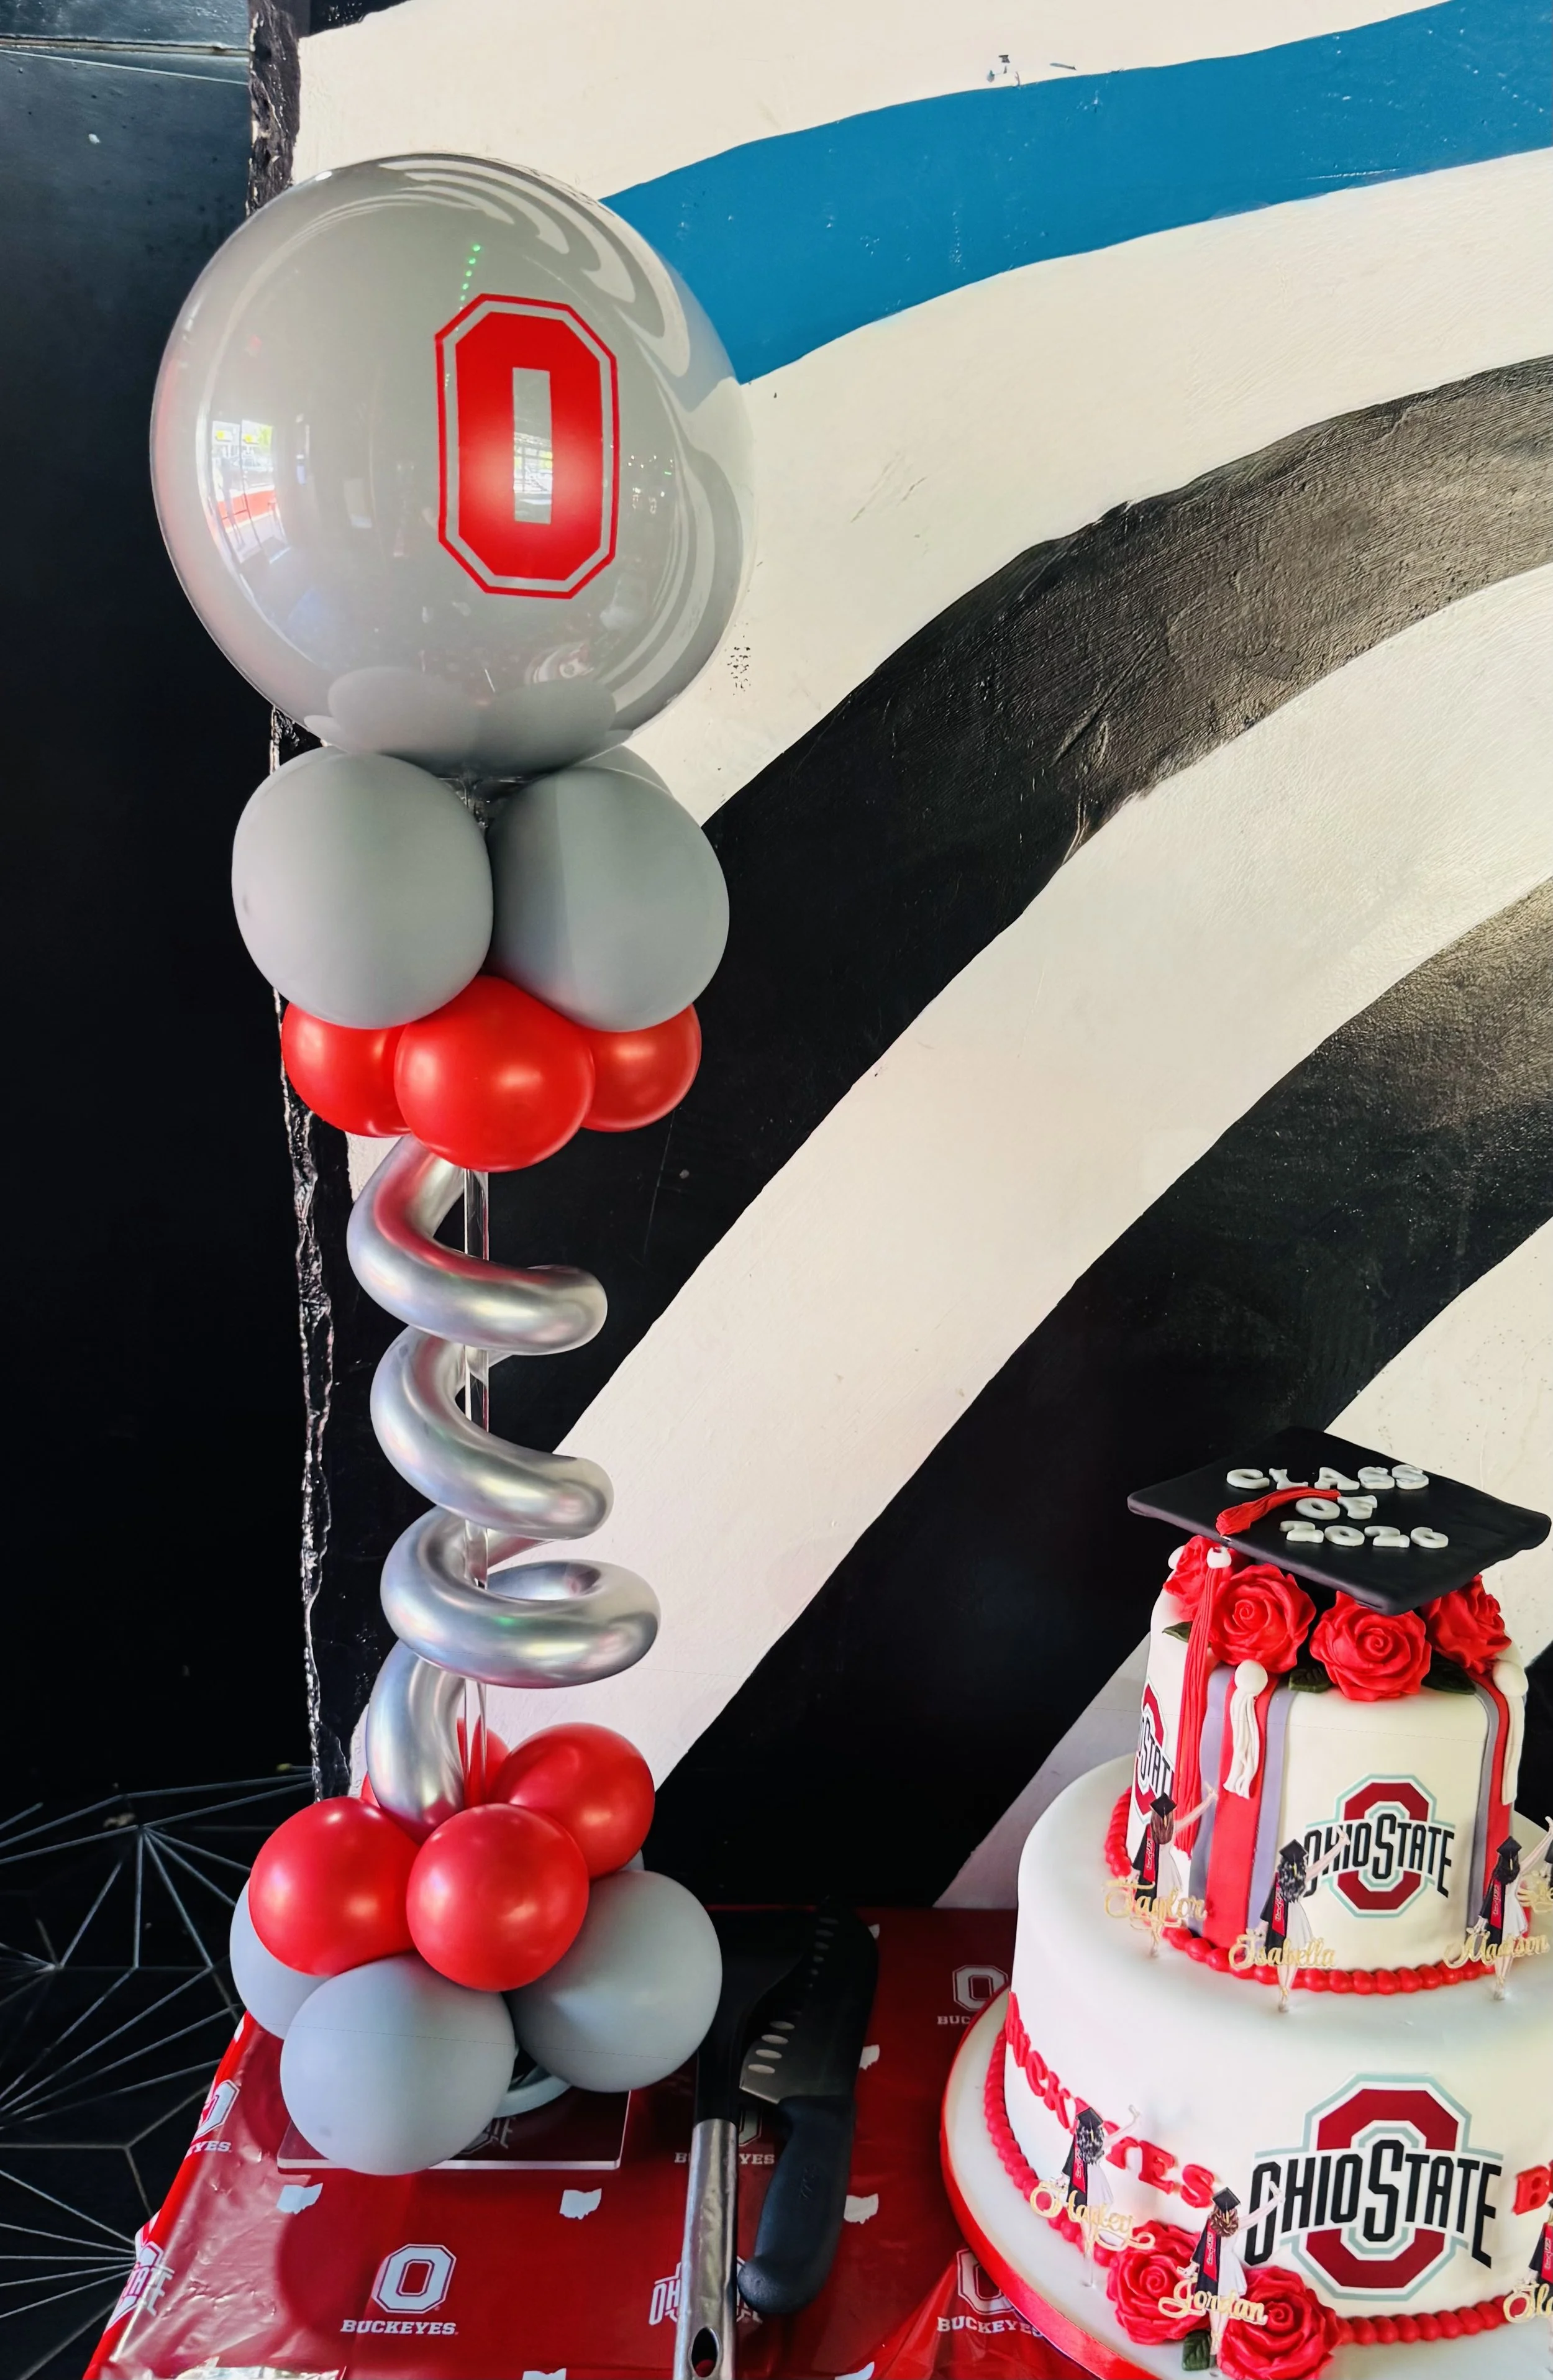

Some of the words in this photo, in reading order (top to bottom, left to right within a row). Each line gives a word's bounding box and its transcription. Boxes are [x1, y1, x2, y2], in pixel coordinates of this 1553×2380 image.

[1226, 1464, 1429, 1490] CLASS
[1295, 1495, 1378, 1520] OF
[1104, 1878, 1208, 1930] Taylor
[1229, 1933, 1337, 1969] Isabella
[1005, 1990, 1216, 2209] BUCKYES
[1158, 2277, 1268, 2326] Jordan
[340, 2319, 457, 2335] BUCKEYES
